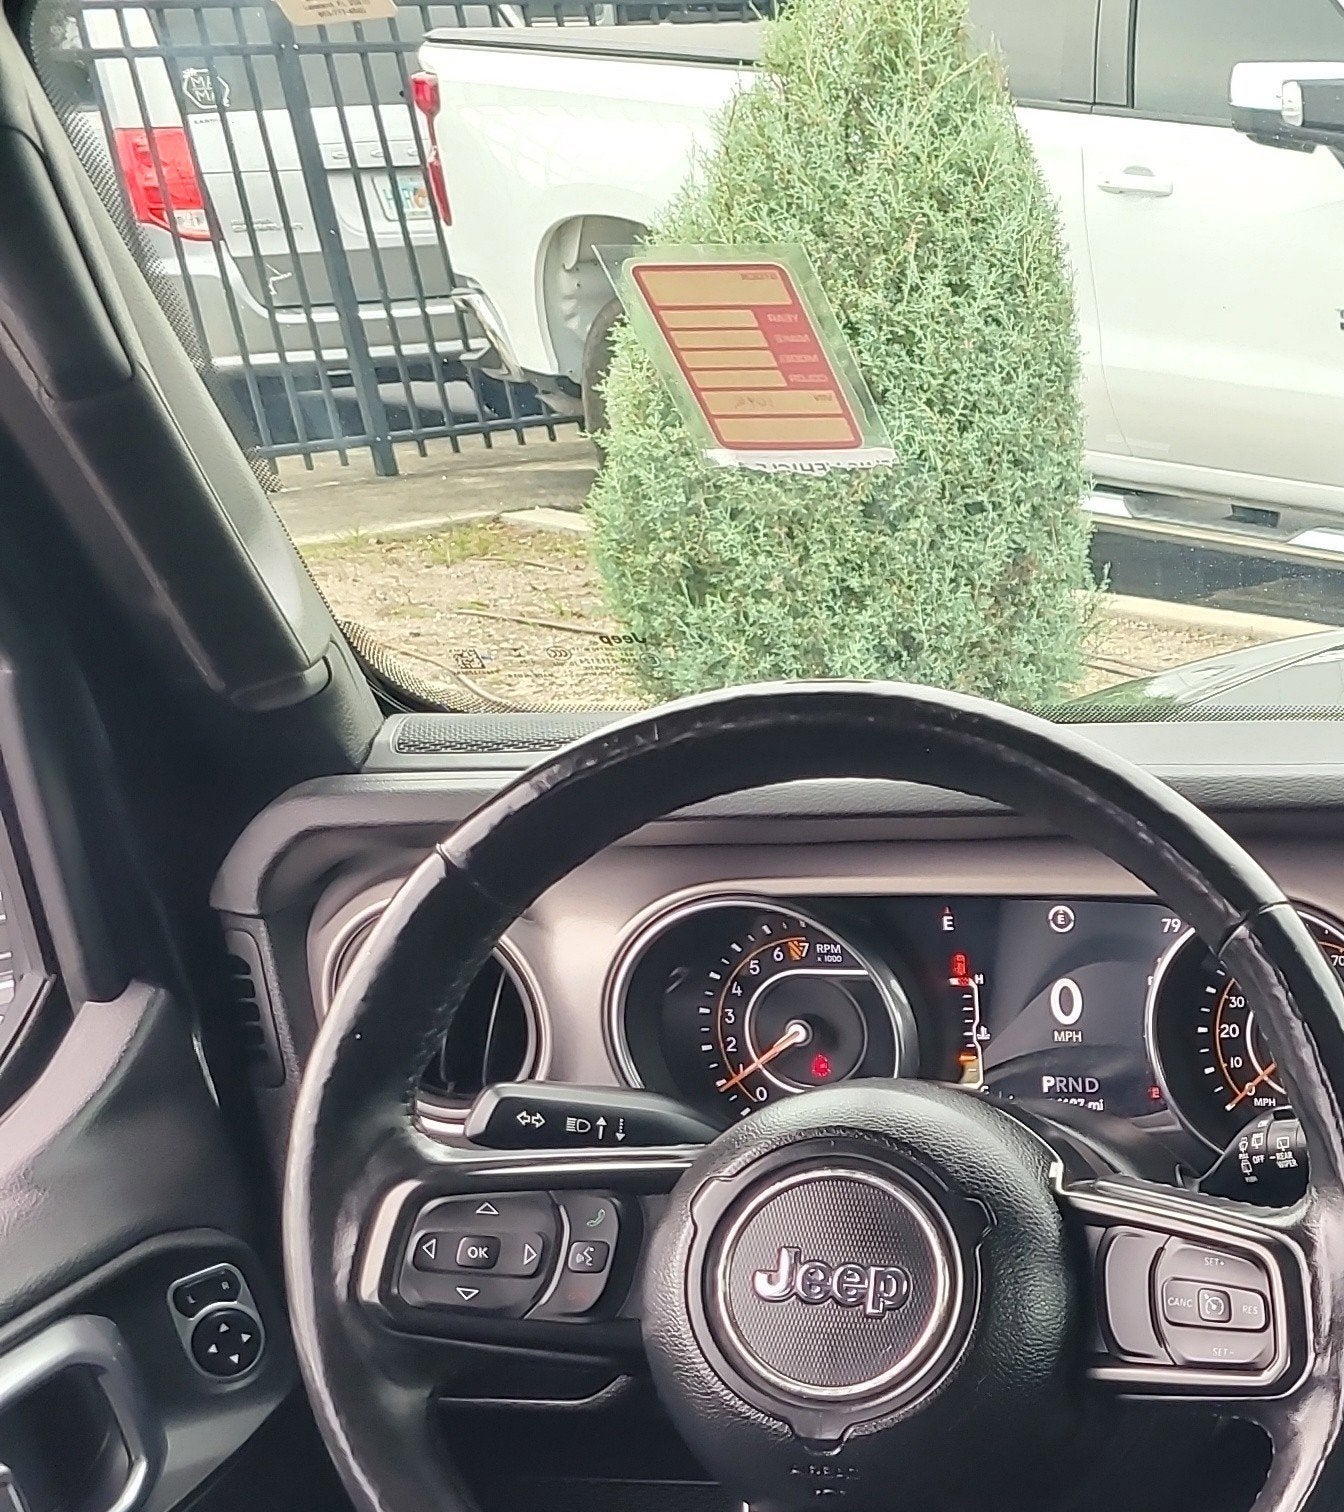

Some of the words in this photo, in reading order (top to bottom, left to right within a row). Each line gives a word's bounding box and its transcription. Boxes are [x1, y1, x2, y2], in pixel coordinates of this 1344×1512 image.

[773, 947, 784, 961] 6
[799, 942, 809, 957] 7
[816, 944, 842, 955] RPM
[824, 955, 843, 963] 1000
[750, 960, 760, 975] 5
[731, 981, 743, 997] 4
[1050, 978, 1083, 1025] 0
[1229, 995, 1245, 1009] 30
[724, 1008, 736, 1024] 3
[1053, 1030, 1083, 1043] MPH
[1219, 1024, 1240, 1038] 20
[726, 1036, 737, 1052] 2
[1230, 1056, 1243, 1068] 10
[1042, 1075, 1100, 1093] PRND
[755, 1086, 768, 1101] 0
[1254, 1098, 1276, 1107] MPH
[1253, 1155, 1264, 1165] OFF
[467, 1246, 489, 1260] OK
[751, 1247, 913, 1318] Jeep
[1167, 1297, 1193, 1309] CANC
[1242, 1304, 1259, 1316] RES
